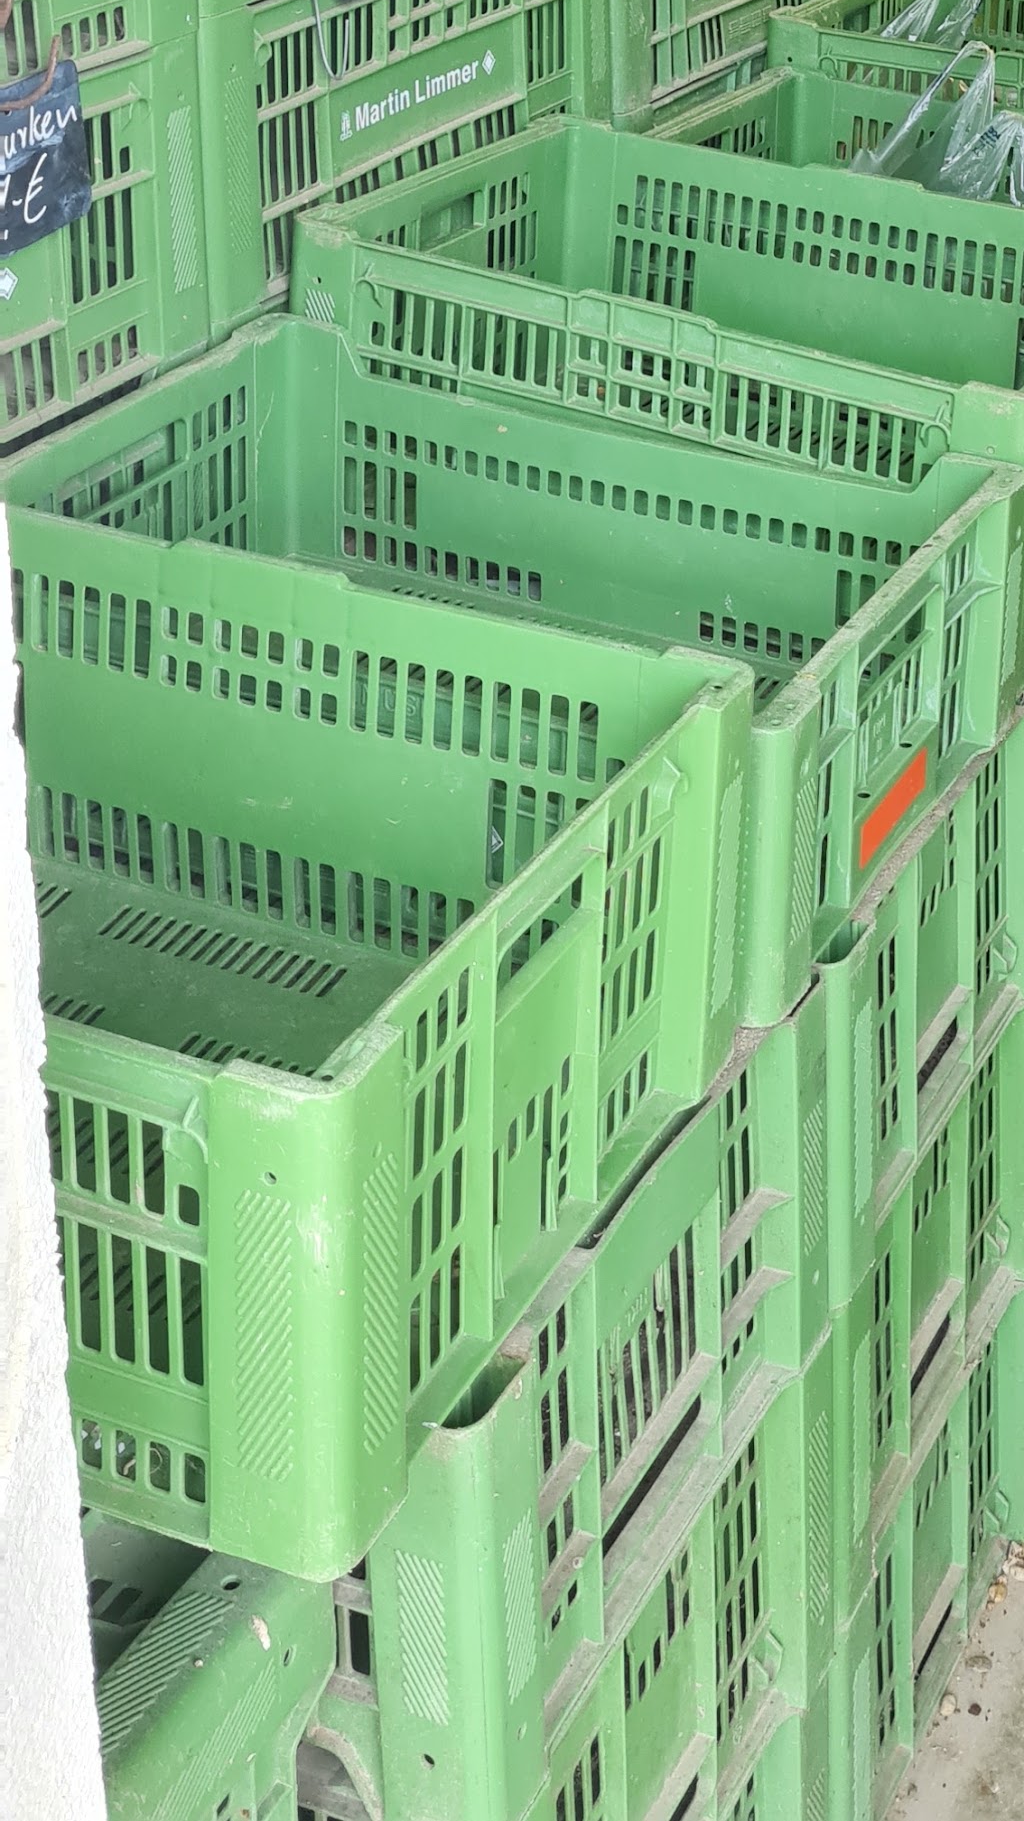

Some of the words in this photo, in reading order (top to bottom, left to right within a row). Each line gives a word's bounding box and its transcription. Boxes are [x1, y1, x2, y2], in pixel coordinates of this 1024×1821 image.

[355, 88, 410, 131] Martin
[415, 59, 479, 103] Limmer
[1, 105, 78, 160] urken
